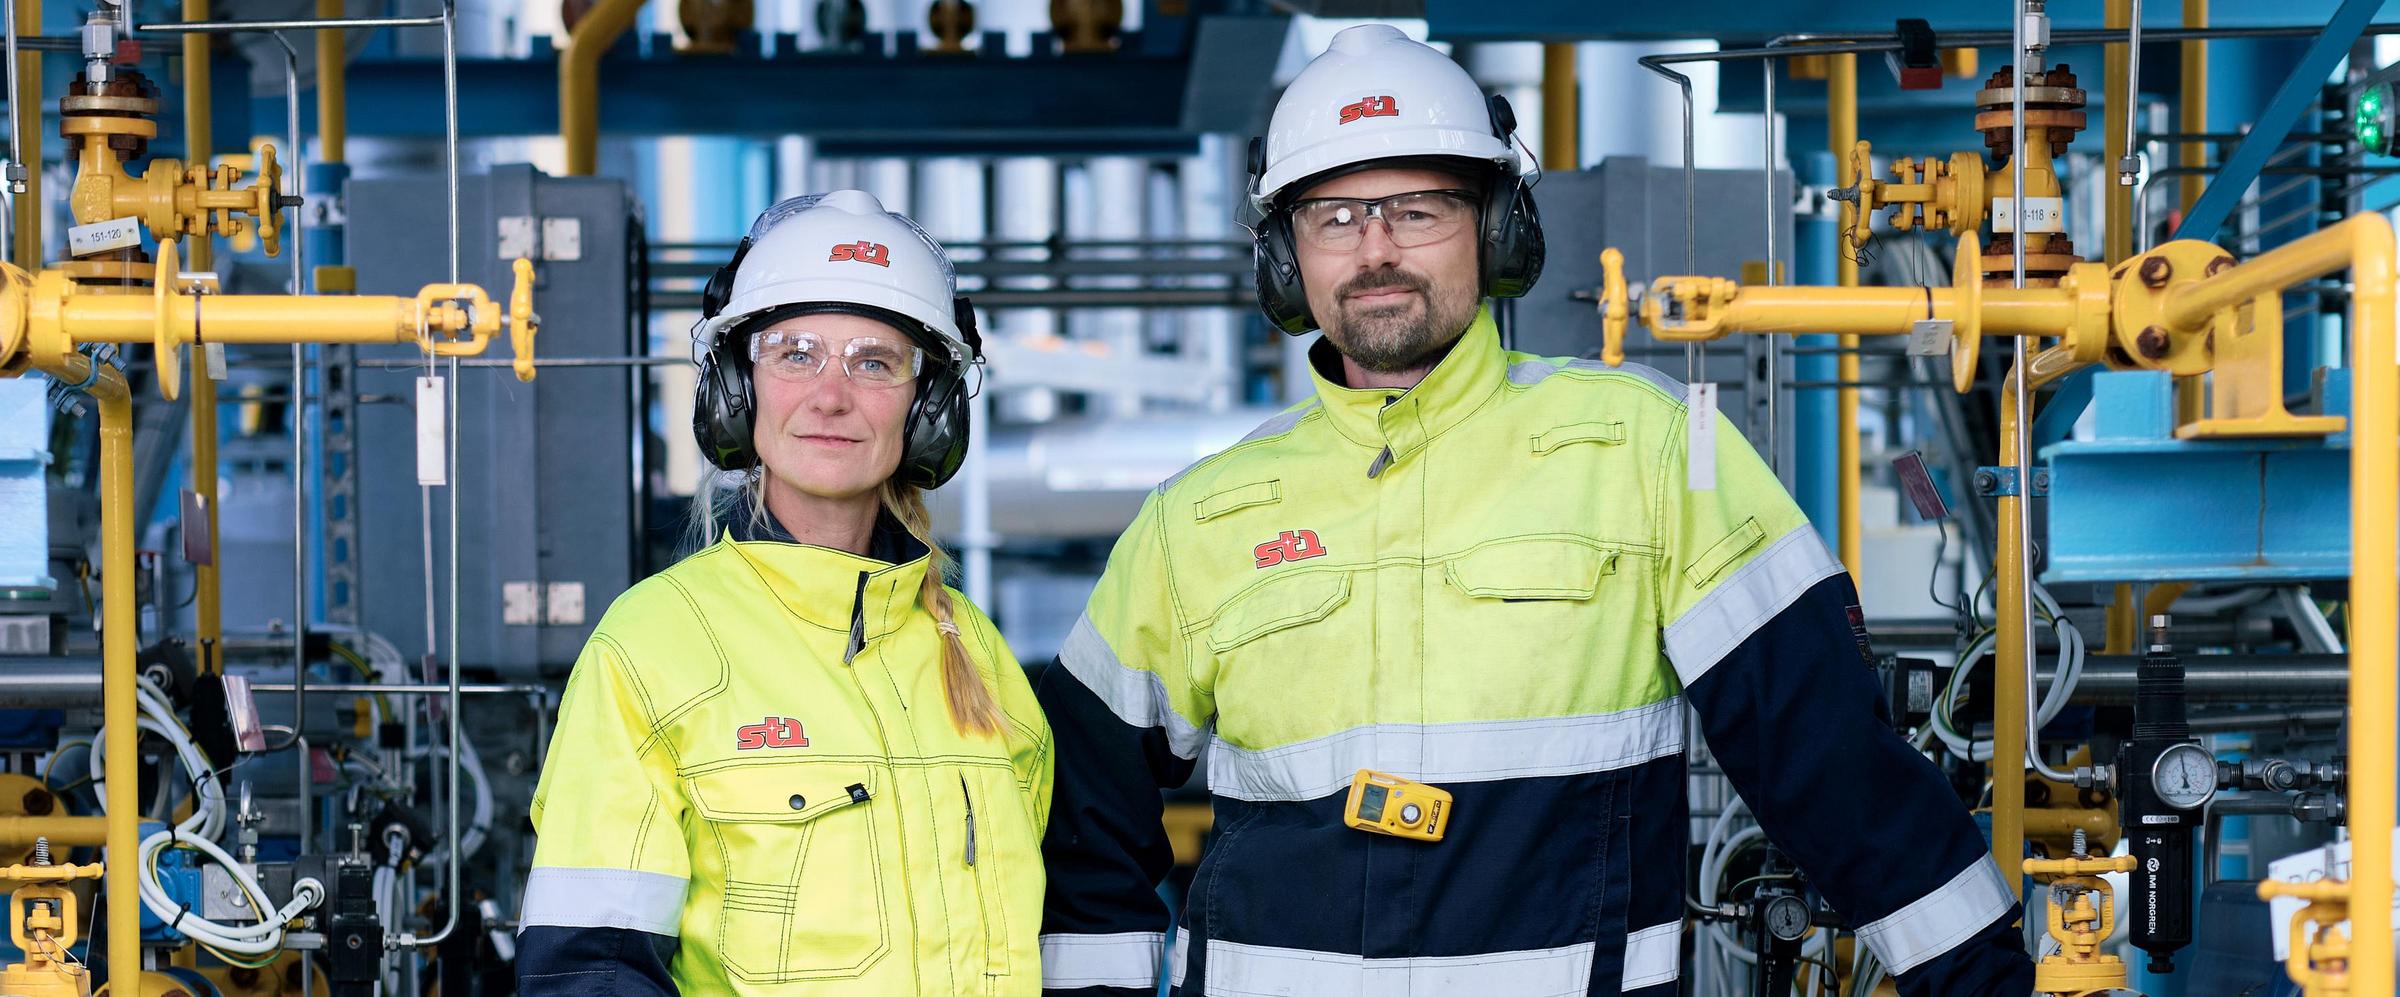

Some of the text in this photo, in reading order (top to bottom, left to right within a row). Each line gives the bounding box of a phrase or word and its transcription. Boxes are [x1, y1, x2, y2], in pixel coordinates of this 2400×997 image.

[1339, 95, 1399, 125] st1
[91, 228, 121, 242] 151-120
[829, 240, 890, 267] st1
[1254, 529, 1327, 569] st1
[737, 717, 809, 750] st1
[2148, 874, 2157, 935] IMI NORGREN
